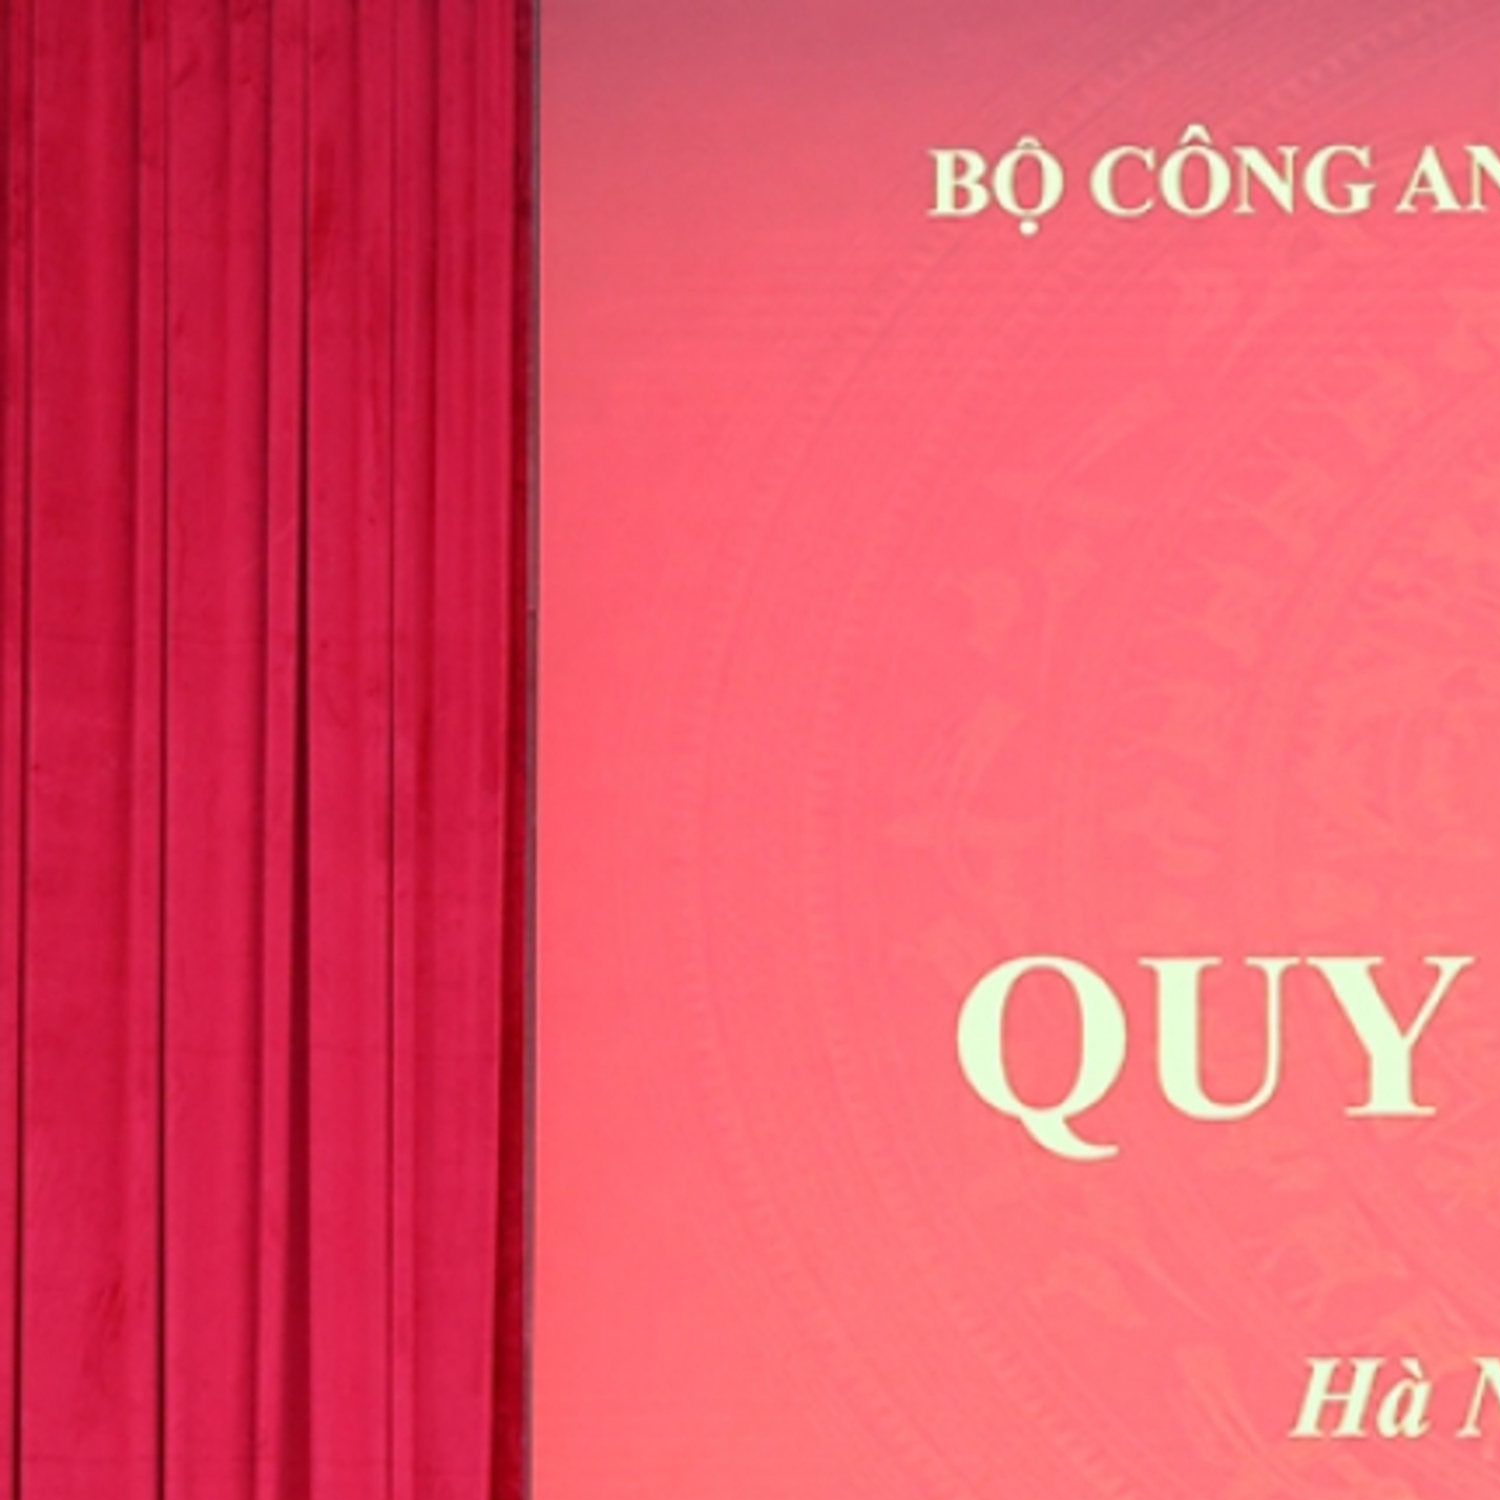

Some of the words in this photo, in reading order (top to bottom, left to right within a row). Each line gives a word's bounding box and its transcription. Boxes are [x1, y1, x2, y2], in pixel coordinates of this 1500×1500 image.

[930, 137, 1064, 235] BỘ
[1090, 124, 1376, 216] CÔNG
[956, 954, 1475, 1161] QUY
[1289, 1356, 1433, 1439] Hà
